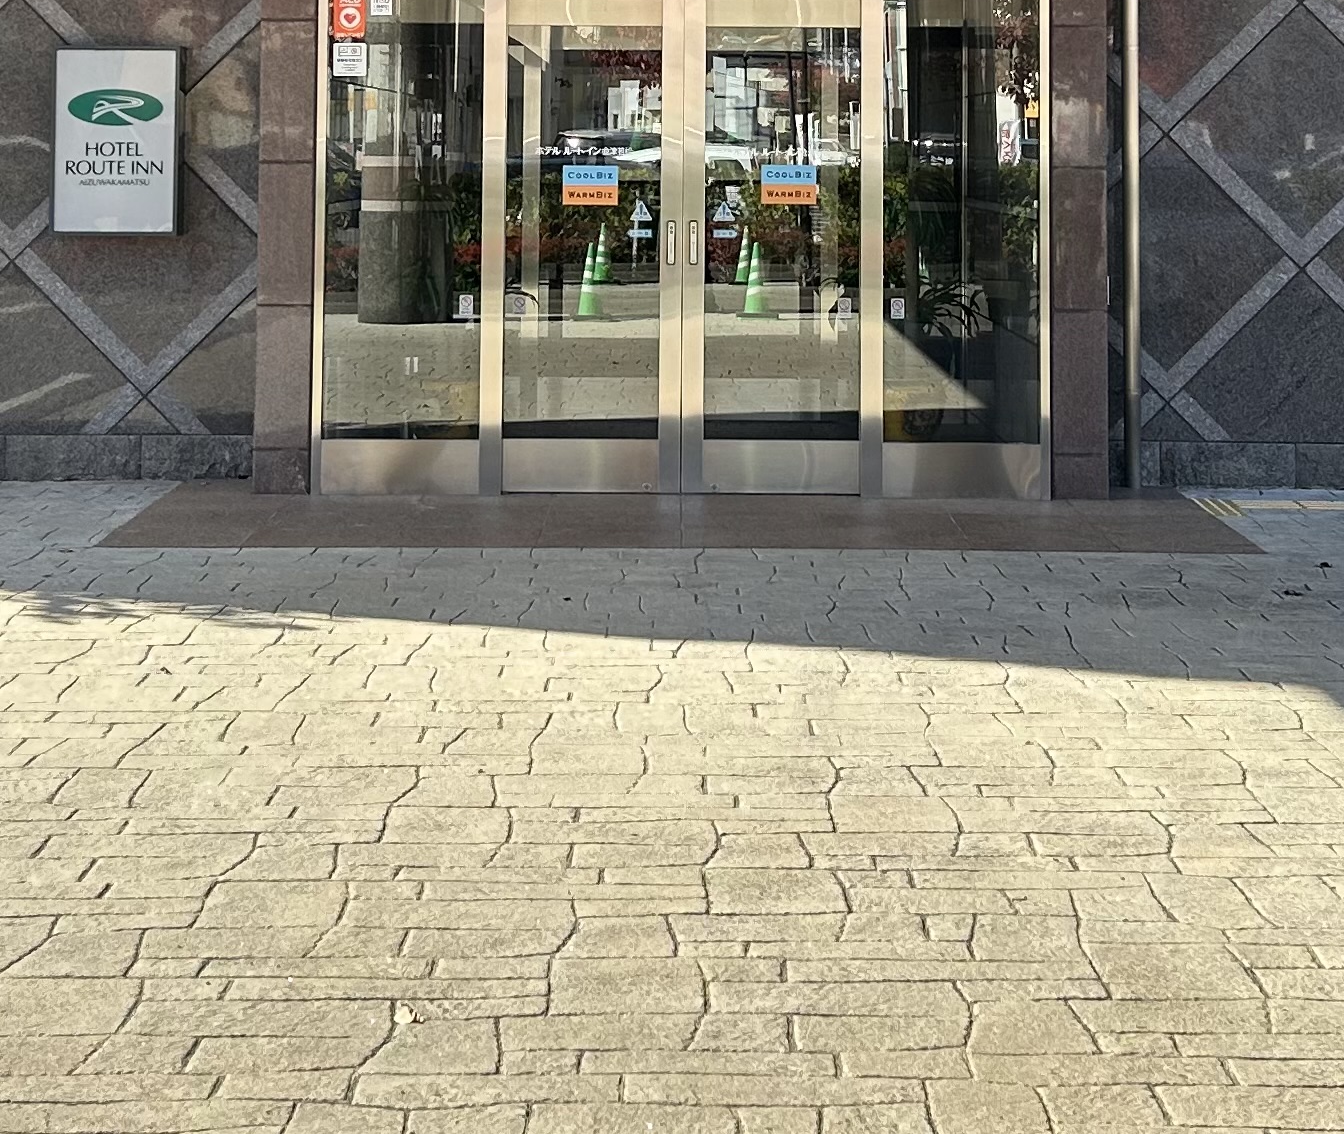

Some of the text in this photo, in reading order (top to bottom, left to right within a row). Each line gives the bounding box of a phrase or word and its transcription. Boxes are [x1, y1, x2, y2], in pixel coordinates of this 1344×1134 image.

[85, 141, 144, 157] HOTEL
[65, 160, 164, 175] ROUTE INN
